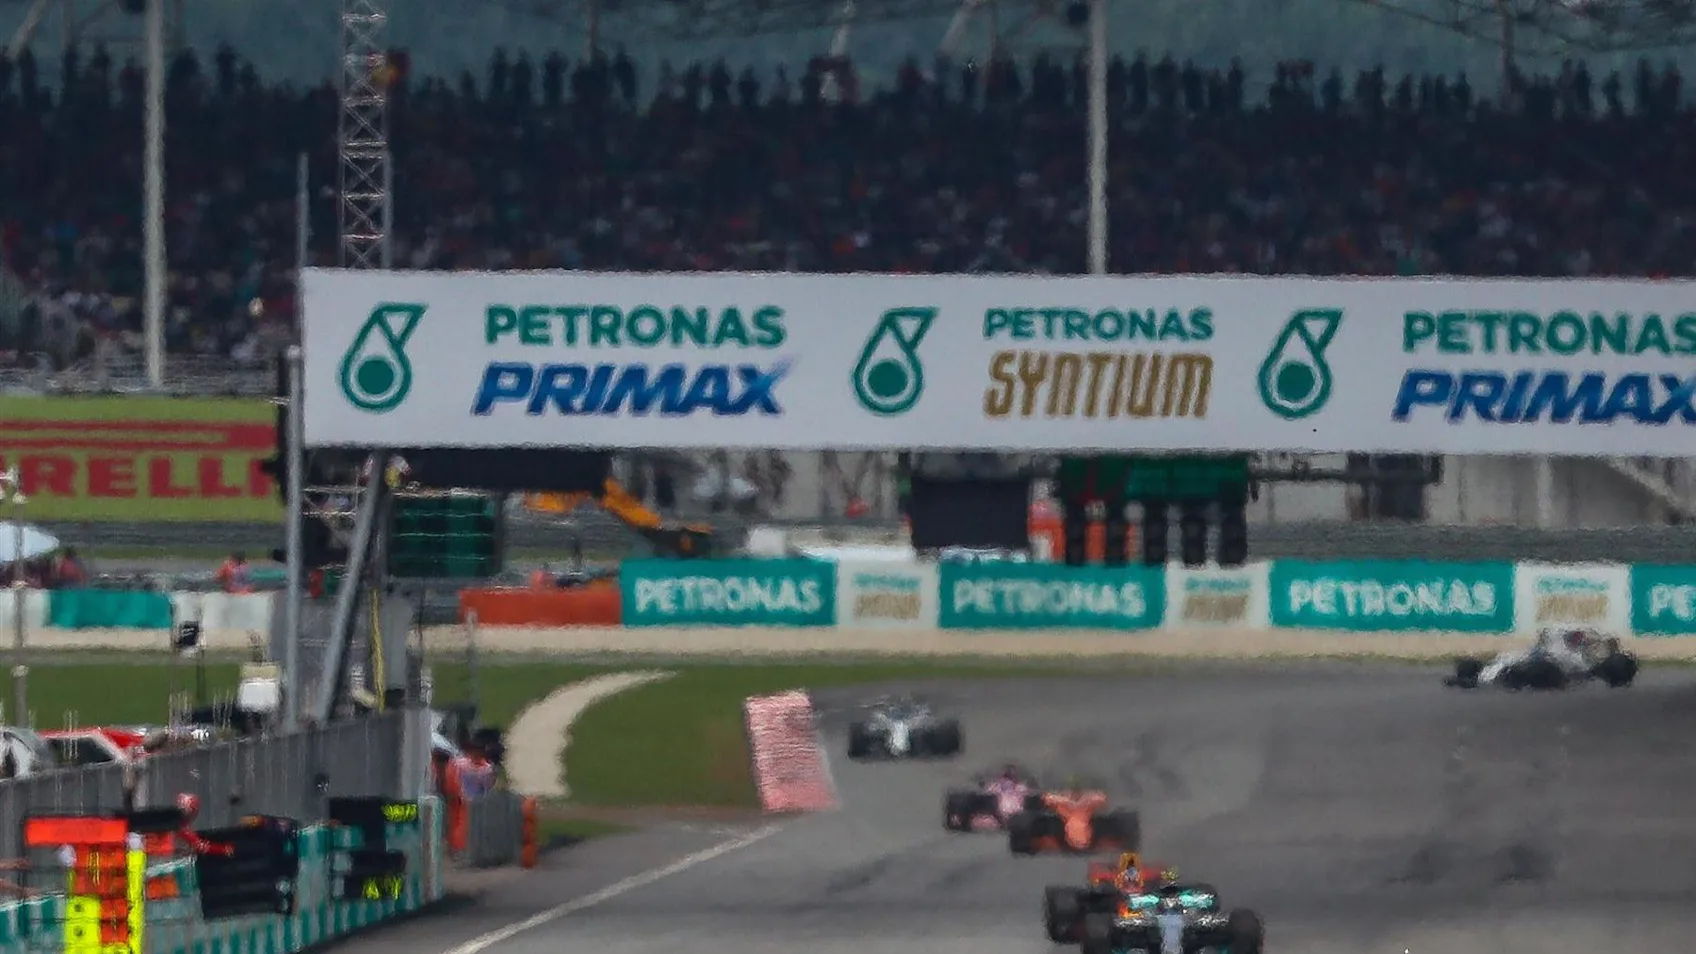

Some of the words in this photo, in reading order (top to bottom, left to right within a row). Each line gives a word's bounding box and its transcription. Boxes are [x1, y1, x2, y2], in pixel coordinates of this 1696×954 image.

[484, 303, 788, 346] PETRONAS
[983, 307, 1215, 341] PETRONAS
[471, 358, 795, 416] PRIMAX
[983, 351, 1215, 418] SYNTIUM
[0, 453, 275, 498] RELLI
[634, 576, 821, 614] PETRONAS
[953, 579, 1147, 617] PETRONAS
[1289, 577, 1496, 616] PETRONAS
